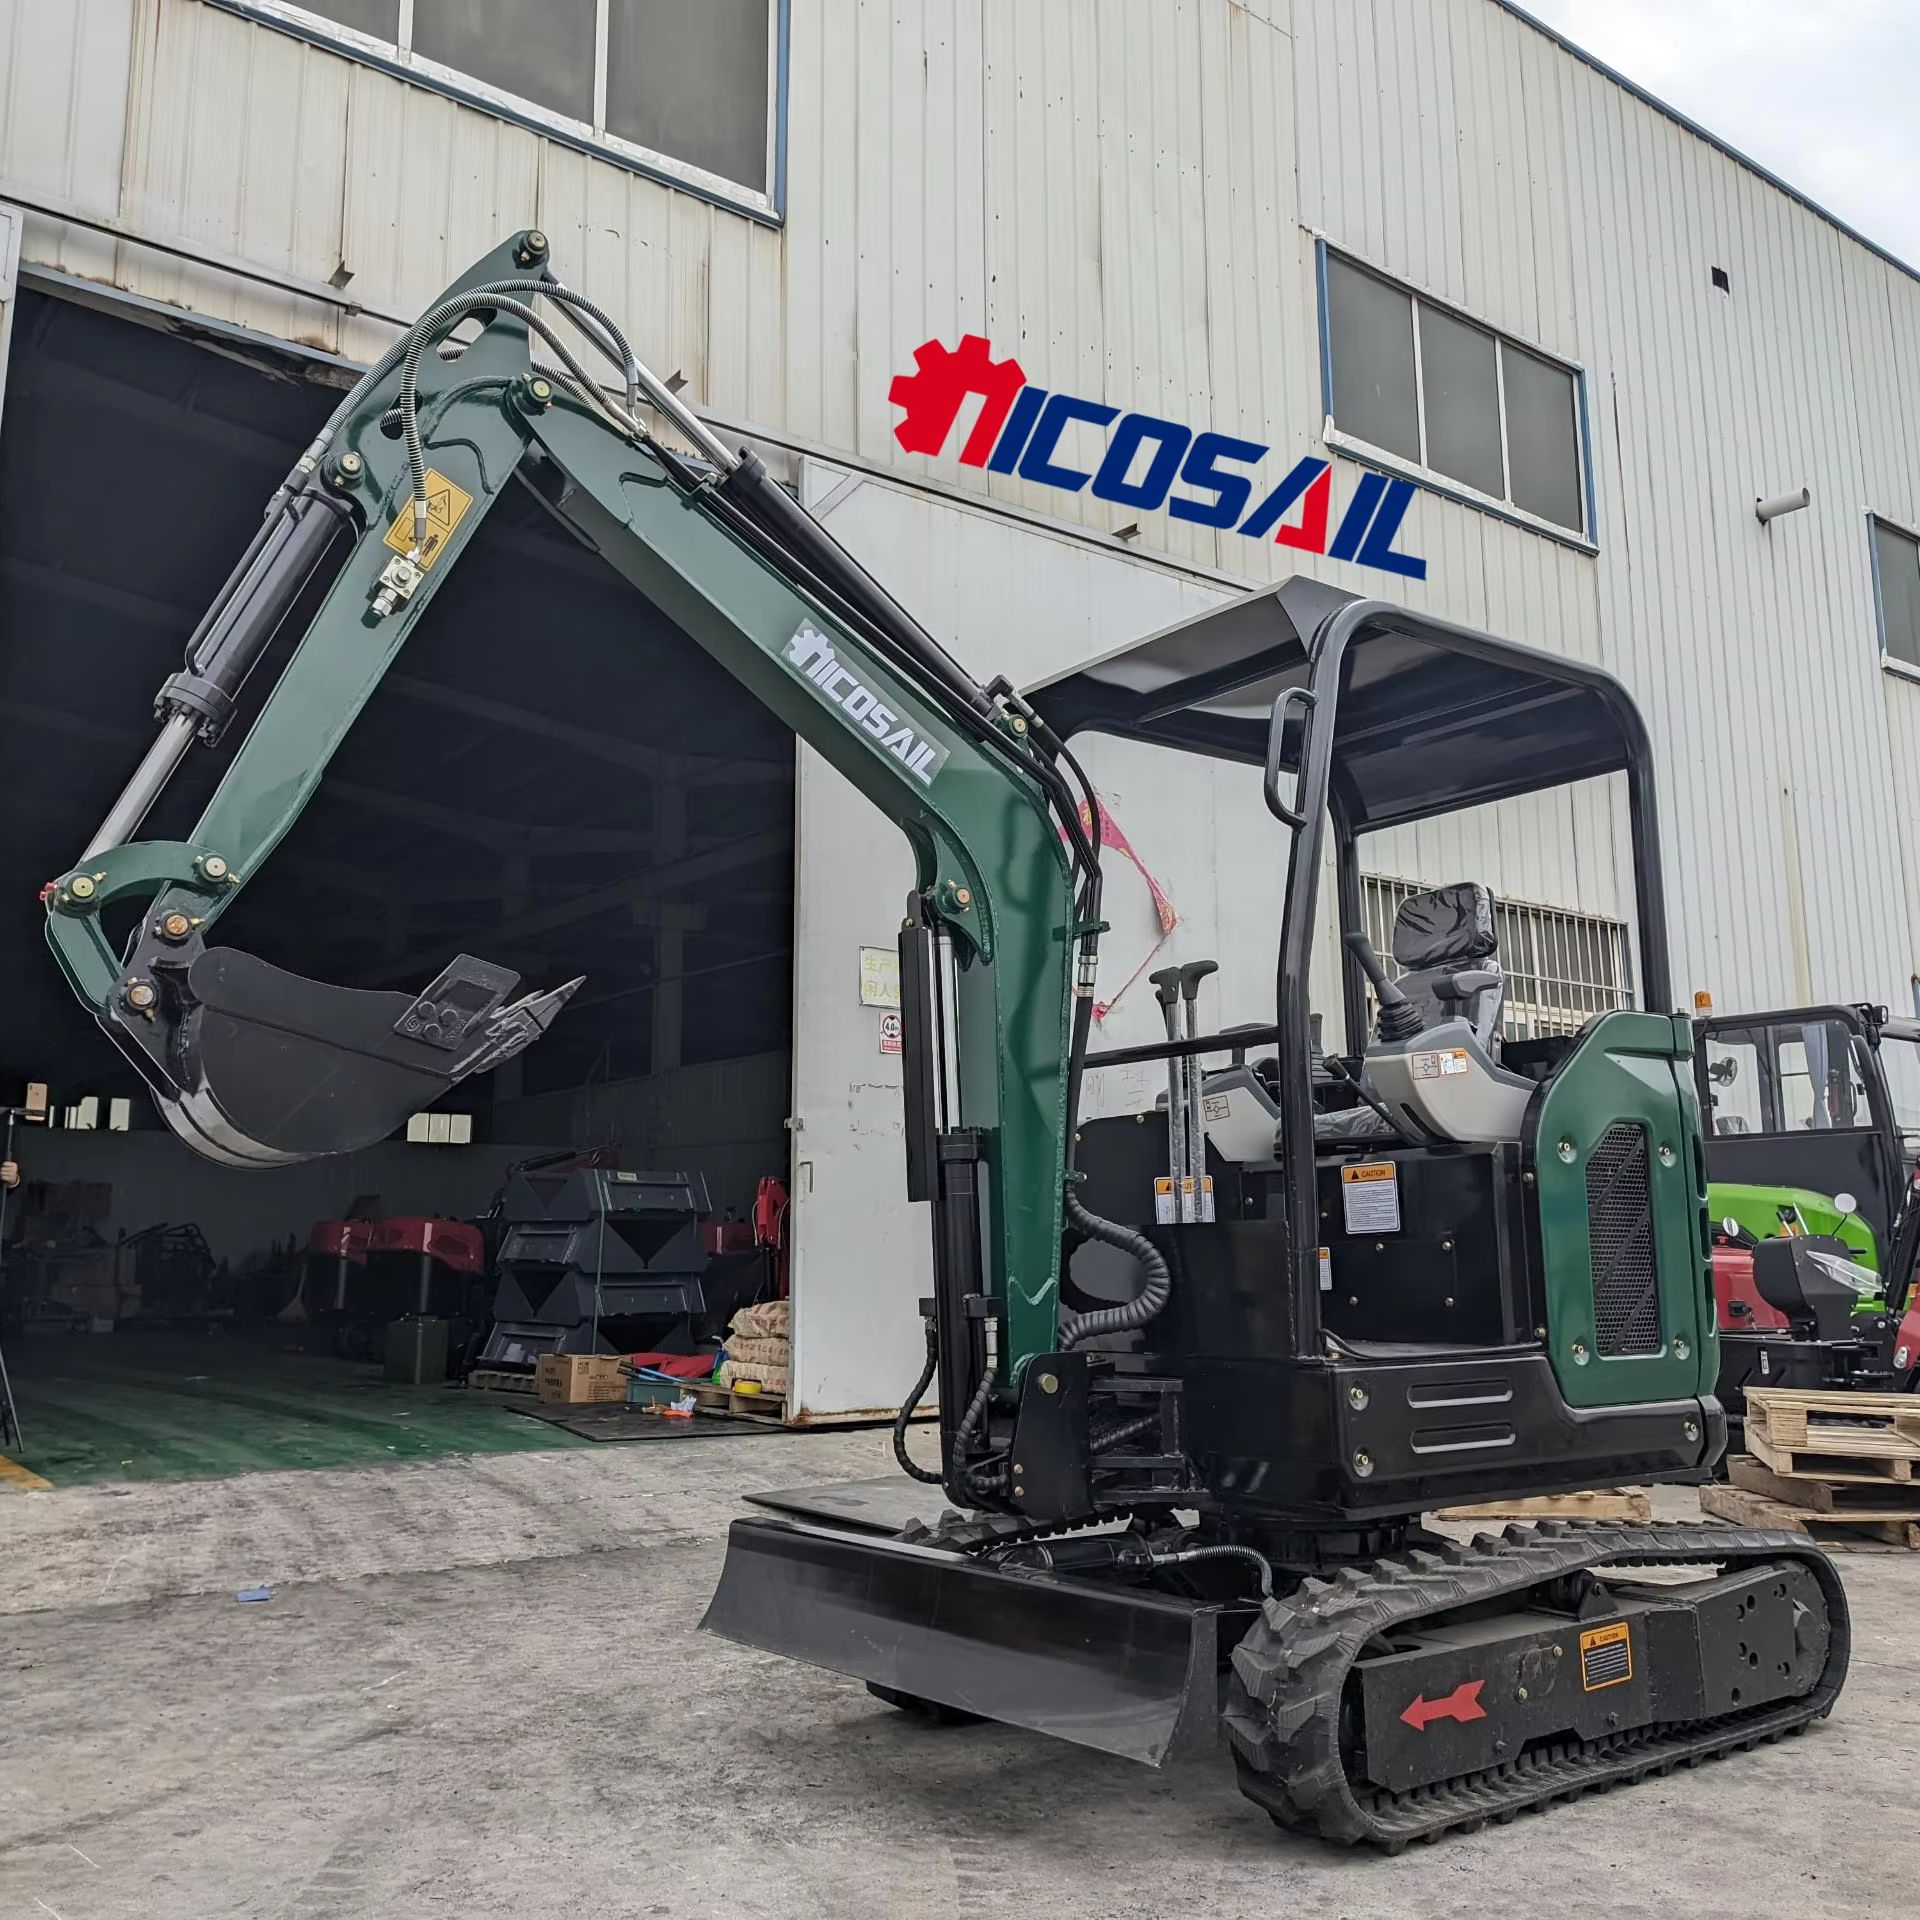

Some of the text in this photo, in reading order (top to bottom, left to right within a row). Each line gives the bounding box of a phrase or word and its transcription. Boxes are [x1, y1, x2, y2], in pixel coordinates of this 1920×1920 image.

[788, 629, 933, 786] NICOSAIL
[864, 955, 899, 974] 生产
[1361, 1169, 1386, 1178] CAUTION
[1600, 1632, 1619, 1643] CAUTION
